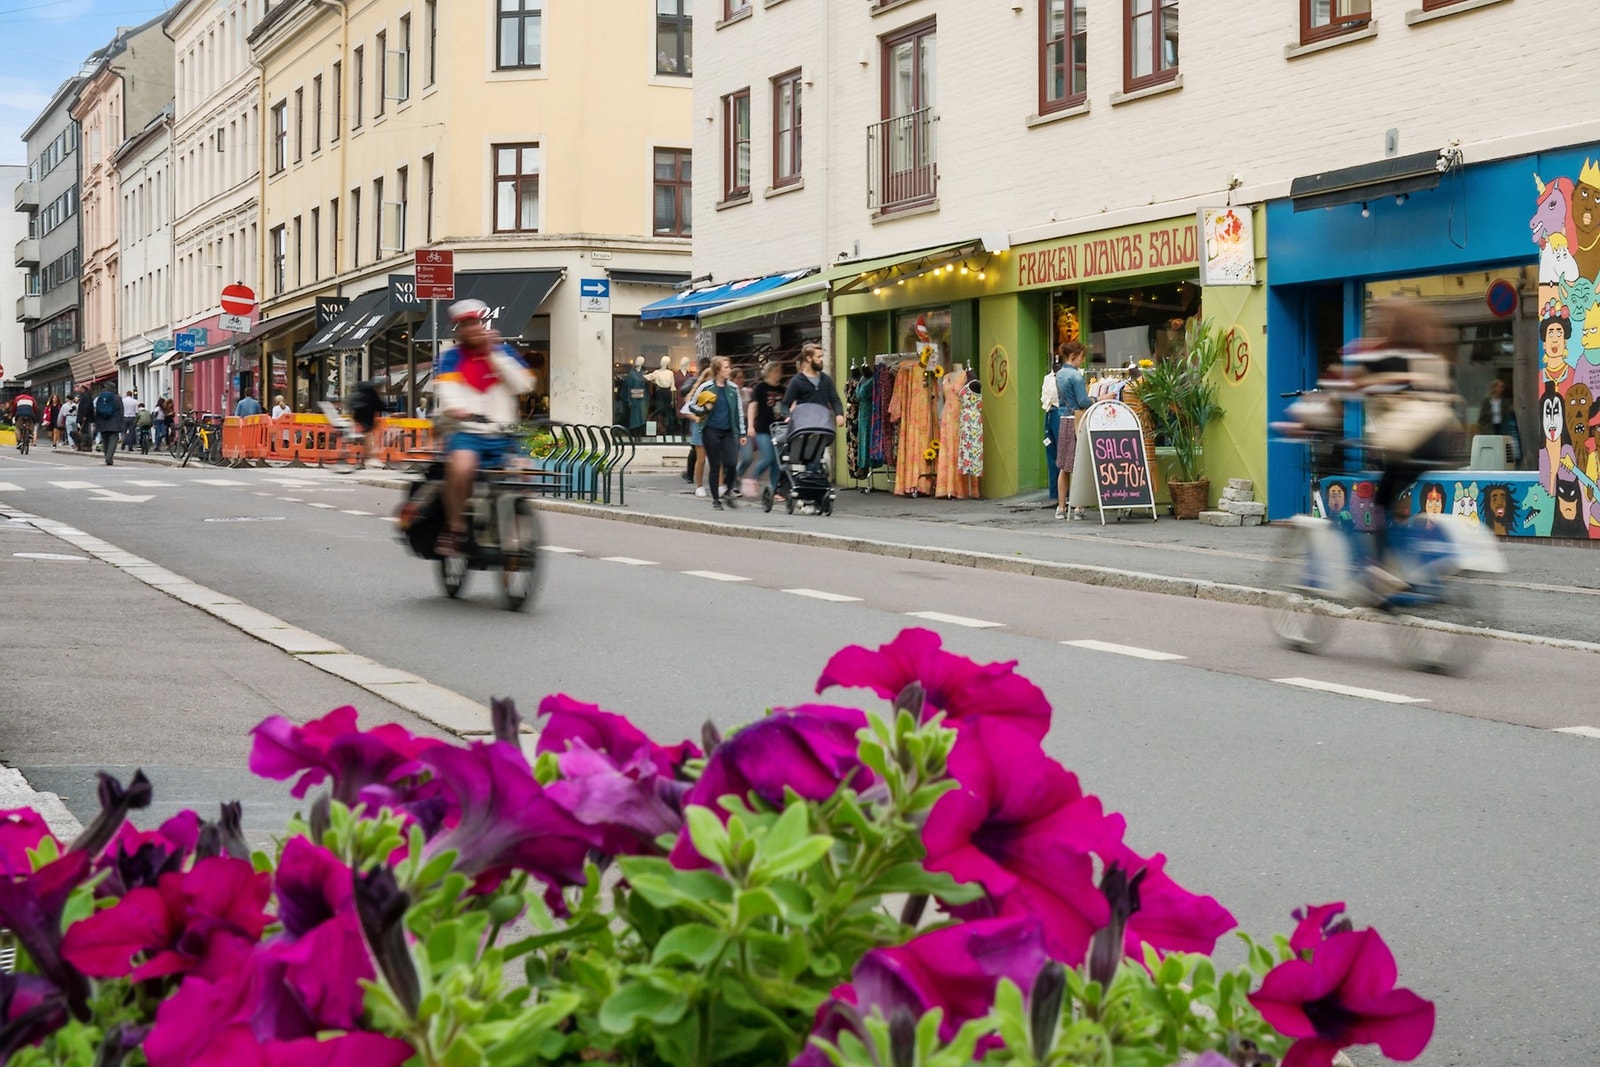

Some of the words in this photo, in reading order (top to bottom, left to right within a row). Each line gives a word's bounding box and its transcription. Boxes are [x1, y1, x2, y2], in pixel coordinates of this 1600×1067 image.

[1018, 245, 1078, 286] FRØKEN
[1083, 234, 1144, 277] DIANAS
[395, 282, 415, 293] NO
[321, 313, 338, 323] NO
[1099, 462, 1147, 488] 50-70%
